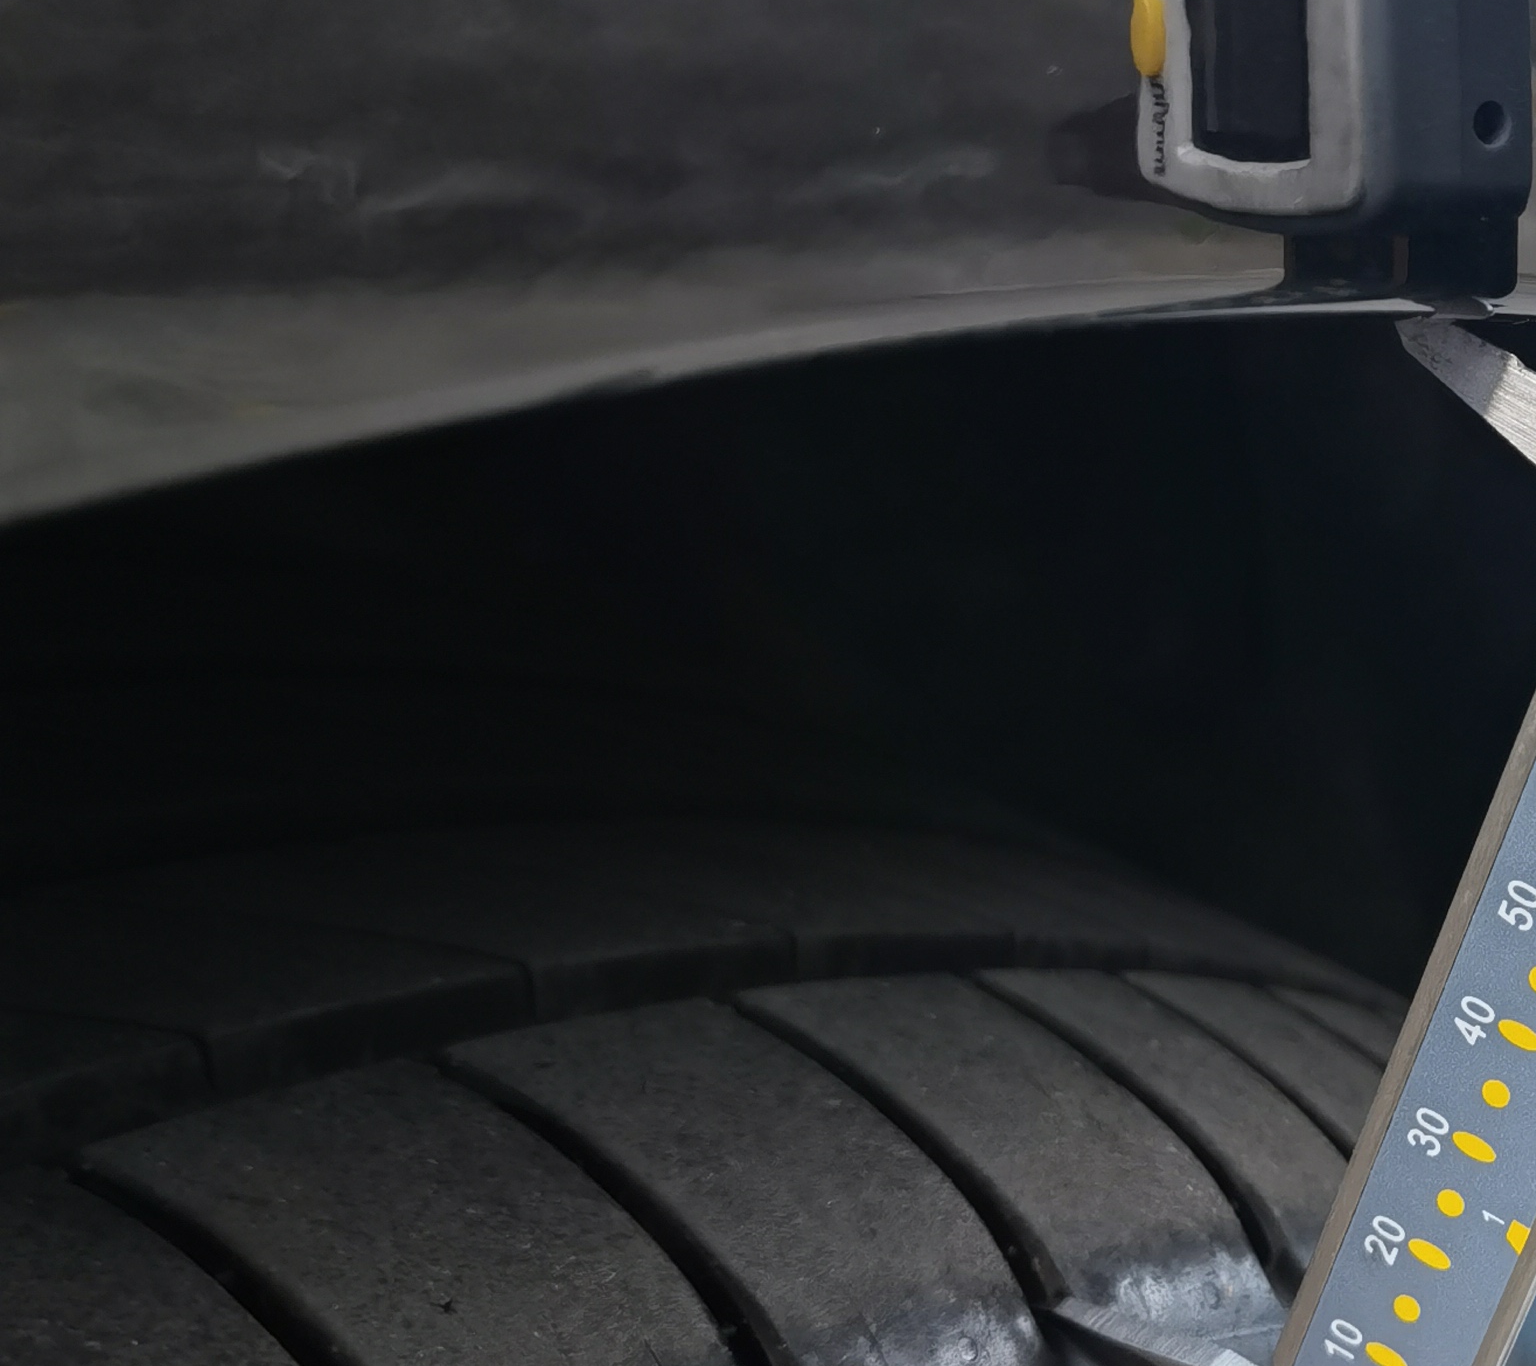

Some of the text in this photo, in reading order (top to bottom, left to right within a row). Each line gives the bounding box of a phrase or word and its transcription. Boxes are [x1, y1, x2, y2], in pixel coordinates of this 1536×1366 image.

[1323, 1317, 1364, 1361] 10
[1364, 1214, 1407, 1267] 20
[1407, 1107, 1450, 1157] 30
[1453, 994, 1496, 1046] 40
[1480, 1208, 1506, 1228] 1
